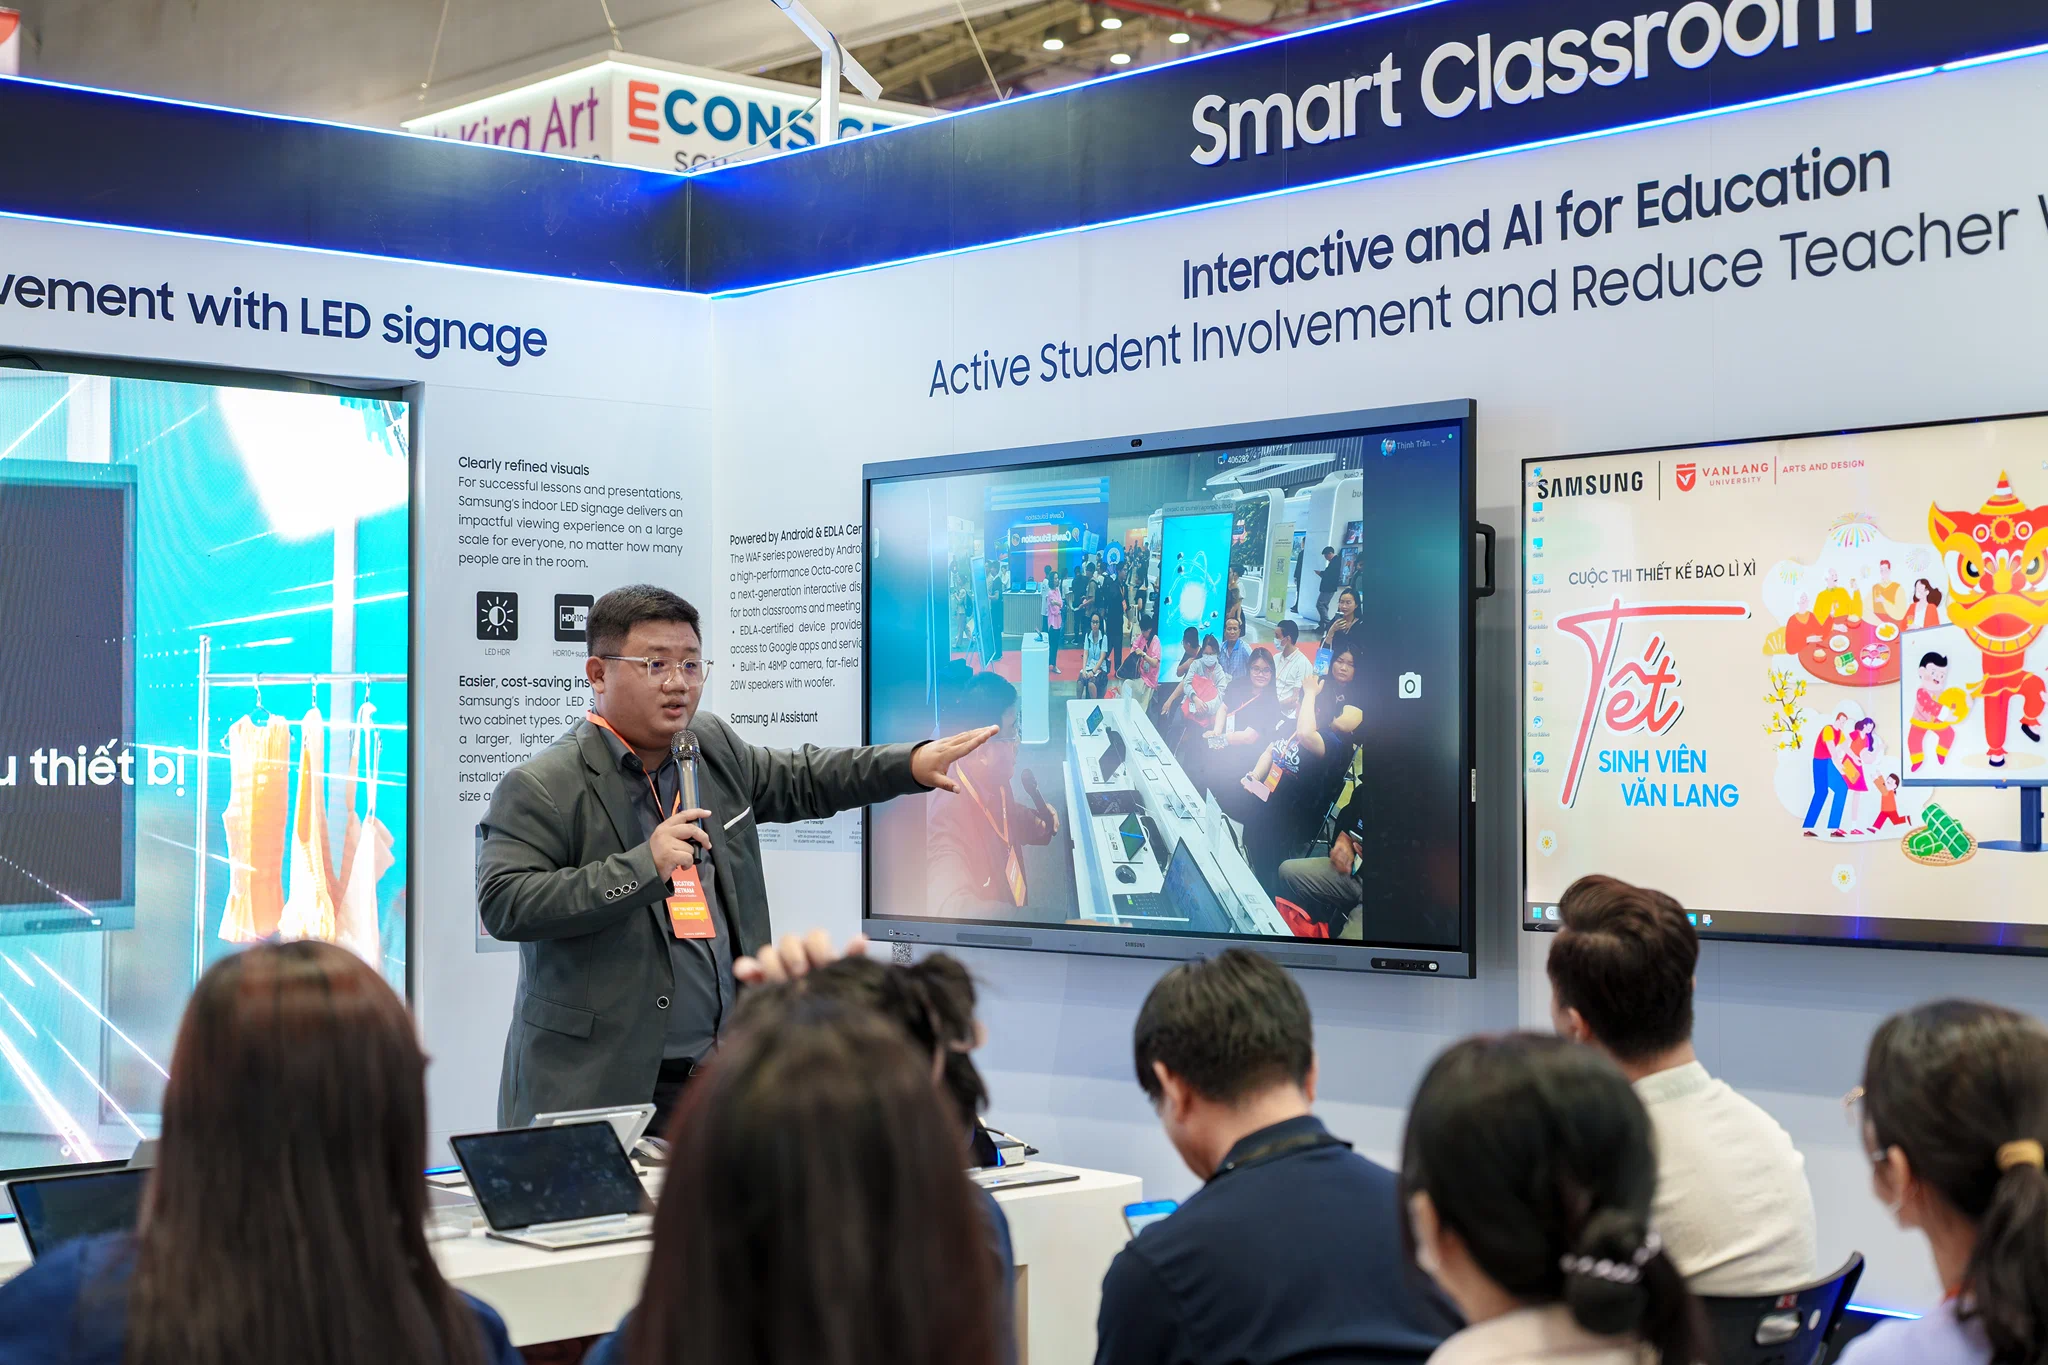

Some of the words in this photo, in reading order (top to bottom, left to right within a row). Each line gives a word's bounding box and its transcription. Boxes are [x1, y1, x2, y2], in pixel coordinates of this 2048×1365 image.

[1190, 52, 1401, 165] Smart
[1420, 0, 1872, 118] Classroom
[541, 87, 599, 152] Art
[1183, 229, 1394, 301] Interactive
[1405, 207, 1491, 264] and
[1503, 200, 1543, 251] AI
[1556, 188, 1624, 240] for
[1637, 147, 1891, 230] Education
[929, 349, 1030, 397] Active
[1040, 324, 1182, 383] Student
[1193, 282, 1452, 363] Involvement
[1465, 268, 1557, 324] and
[1572, 240, 1763, 310] Reduce
[1779, 205, 2019, 281] Teacher
[187, 286, 288, 331] with
[301, 298, 371, 340] LED
[382, 306, 547, 366] signage
[458, 457, 502, 473] Clearly
[504, 459, 548, 473] refined
[550, 461, 590, 475] visuals
[1228, 454, 1250, 464] 406282
[1782, 464, 1805, 474] ARTS
[1808, 462, 1828, 473] AND
[1831, 459, 1865, 471] DESIGN
[1702, 462, 1769, 476] VANLANG
[458, 476, 477, 488] For
[479, 478, 539, 492] successful
[541, 481, 582, 494] lessons
[584, 485, 606, 495] and
[607, 486, 683, 501] presentations,
[1537, 470, 1644, 500] SAMSUNG
[1709, 476, 1762, 486] UNIVERSITY
[522, 498, 558, 511] indoor
[560, 501, 579, 512] LED
[581, 502, 625, 518] signage
[626, 504, 667, 518] delivers
[669, 508, 683, 518] an
[458, 513, 513, 529] impactful
[516, 517, 560, 533] viewing
[563, 520, 625, 534] experience
[628, 524, 642, 534] on
[645, 525, 653, 534] a
[655, 524, 683, 539] large
[730, 532, 767, 546] Powered
[768, 531, 778, 545] by
[780, 526, 814, 541] Android
[816, 527, 822, 538] &
[824, 525, 844, 538] EDLA
[458, 534, 490, 546] scale
[492, 534, 508, 546] for
[511, 537, 567, 551] everyone,
[569, 540, 584, 550] no
[586, 539, 624, 551] matter
[626, 541, 650, 553] how
[652, 544, 683, 557] many
[730, 552, 745, 564] The
[745, 550, 762, 563] WAF
[762, 549, 786, 561] series
[786, 545, 824, 562] powered
[824, 545, 835, 558] by
[458, 553, 499, 567] people
[501, 555, 521, 566] are
[523, 555, 533, 566] in
[535, 555, 554, 567] the
[556, 558, 589, 568] room.
[730, 573, 736, 582] a
[736, 567, 810, 585] high-performance
[811, 563, 854, 577] Octa-core
[1568, 566, 1609, 587] CUỘC
[1612, 568, 1633, 583] THI
[1636, 560, 1671, 582] THIẾT
[1675, 559, 1692, 580] KẾ
[1695, 563, 1725, 579] BAO
[1728, 559, 1741, 577] LÌ
[1743, 557, 1756, 576] XÌ
[730, 591, 736, 600] a
[737, 585, 801, 602] next-generation
[803, 582, 847, 596] interactive
[849, 580, 862, 594] dis
[730, 607, 741, 618] for
[742, 605, 761, 618] both
[762, 603, 807, 616] classrooms
[808, 602, 825, 614] and
[826, 600, 861, 615] meeting
[740, 622, 794, 636] EDLA-certified
[798, 620, 826, 633] device
[485, 648, 496, 656] LED
[497, 648, 511, 656] HDR
[553, 649, 575, 657] HDR10+
[730, 645, 758, 655] access
[759, 643, 767, 653] to
[768, 641, 797, 656] Google
[799, 642, 819, 655] apps
[821, 638, 837, 650] and
[741, 658, 766, 672] Built-in
[767, 659, 788, 672] 48MP
[789, 659, 824, 671] camera,
[825, 656, 859, 669] far-field
[459, 675, 498, 689] Easier,
[501, 675, 572, 691] cost-saving
[730, 679, 746, 691] 20W
[747, 677, 784, 692] speakers
[785, 676, 802, 689] with
[804, 675, 836, 688] woofer.
[525, 696, 560, 707] indoor
[566, 696, 584, 707] LED
[1554, 598, 1752, 808] Tết
[459, 714, 482, 725] two
[484, 714, 527, 726] cabinet
[529, 715, 563, 729] types.
[730, 712, 769, 727] Samsung
[770, 712, 778, 723] AI
[780, 710, 818, 723] Assistant
[459, 735, 467, 744] a
[475, 733, 512, 747] larger,
[520, 733, 555, 747] lighter
[1599, 750, 1649, 773] SINH
[1656, 743, 1707, 773] VIÊN
[30, 739, 134, 787] thiết
[147, 747, 186, 797] bị
[459, 790, 481, 802] size
[1621, 780, 1668, 807] VĂN
[1673, 783, 1739, 808] LANG
